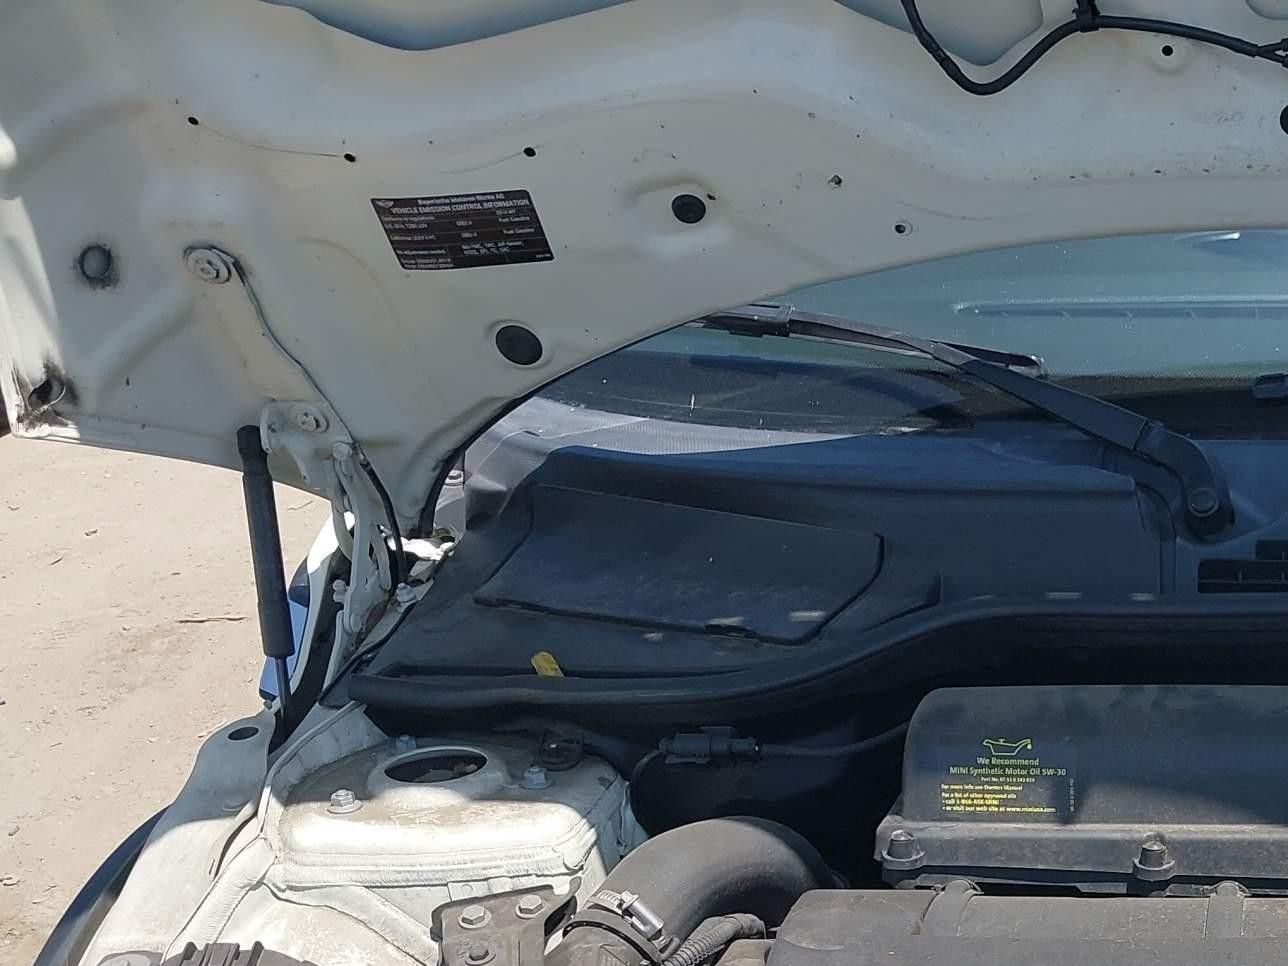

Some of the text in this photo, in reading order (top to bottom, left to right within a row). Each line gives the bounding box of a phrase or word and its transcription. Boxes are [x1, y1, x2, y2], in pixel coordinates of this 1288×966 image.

[991, 757, 1040, 766] Recommend
[949, 767, 968, 775] MINI
[969, 767, 1004, 777] Synthetic
[1029, 768, 1041, 776] Oil
[1041, 768, 1067, 776] 5W-30
